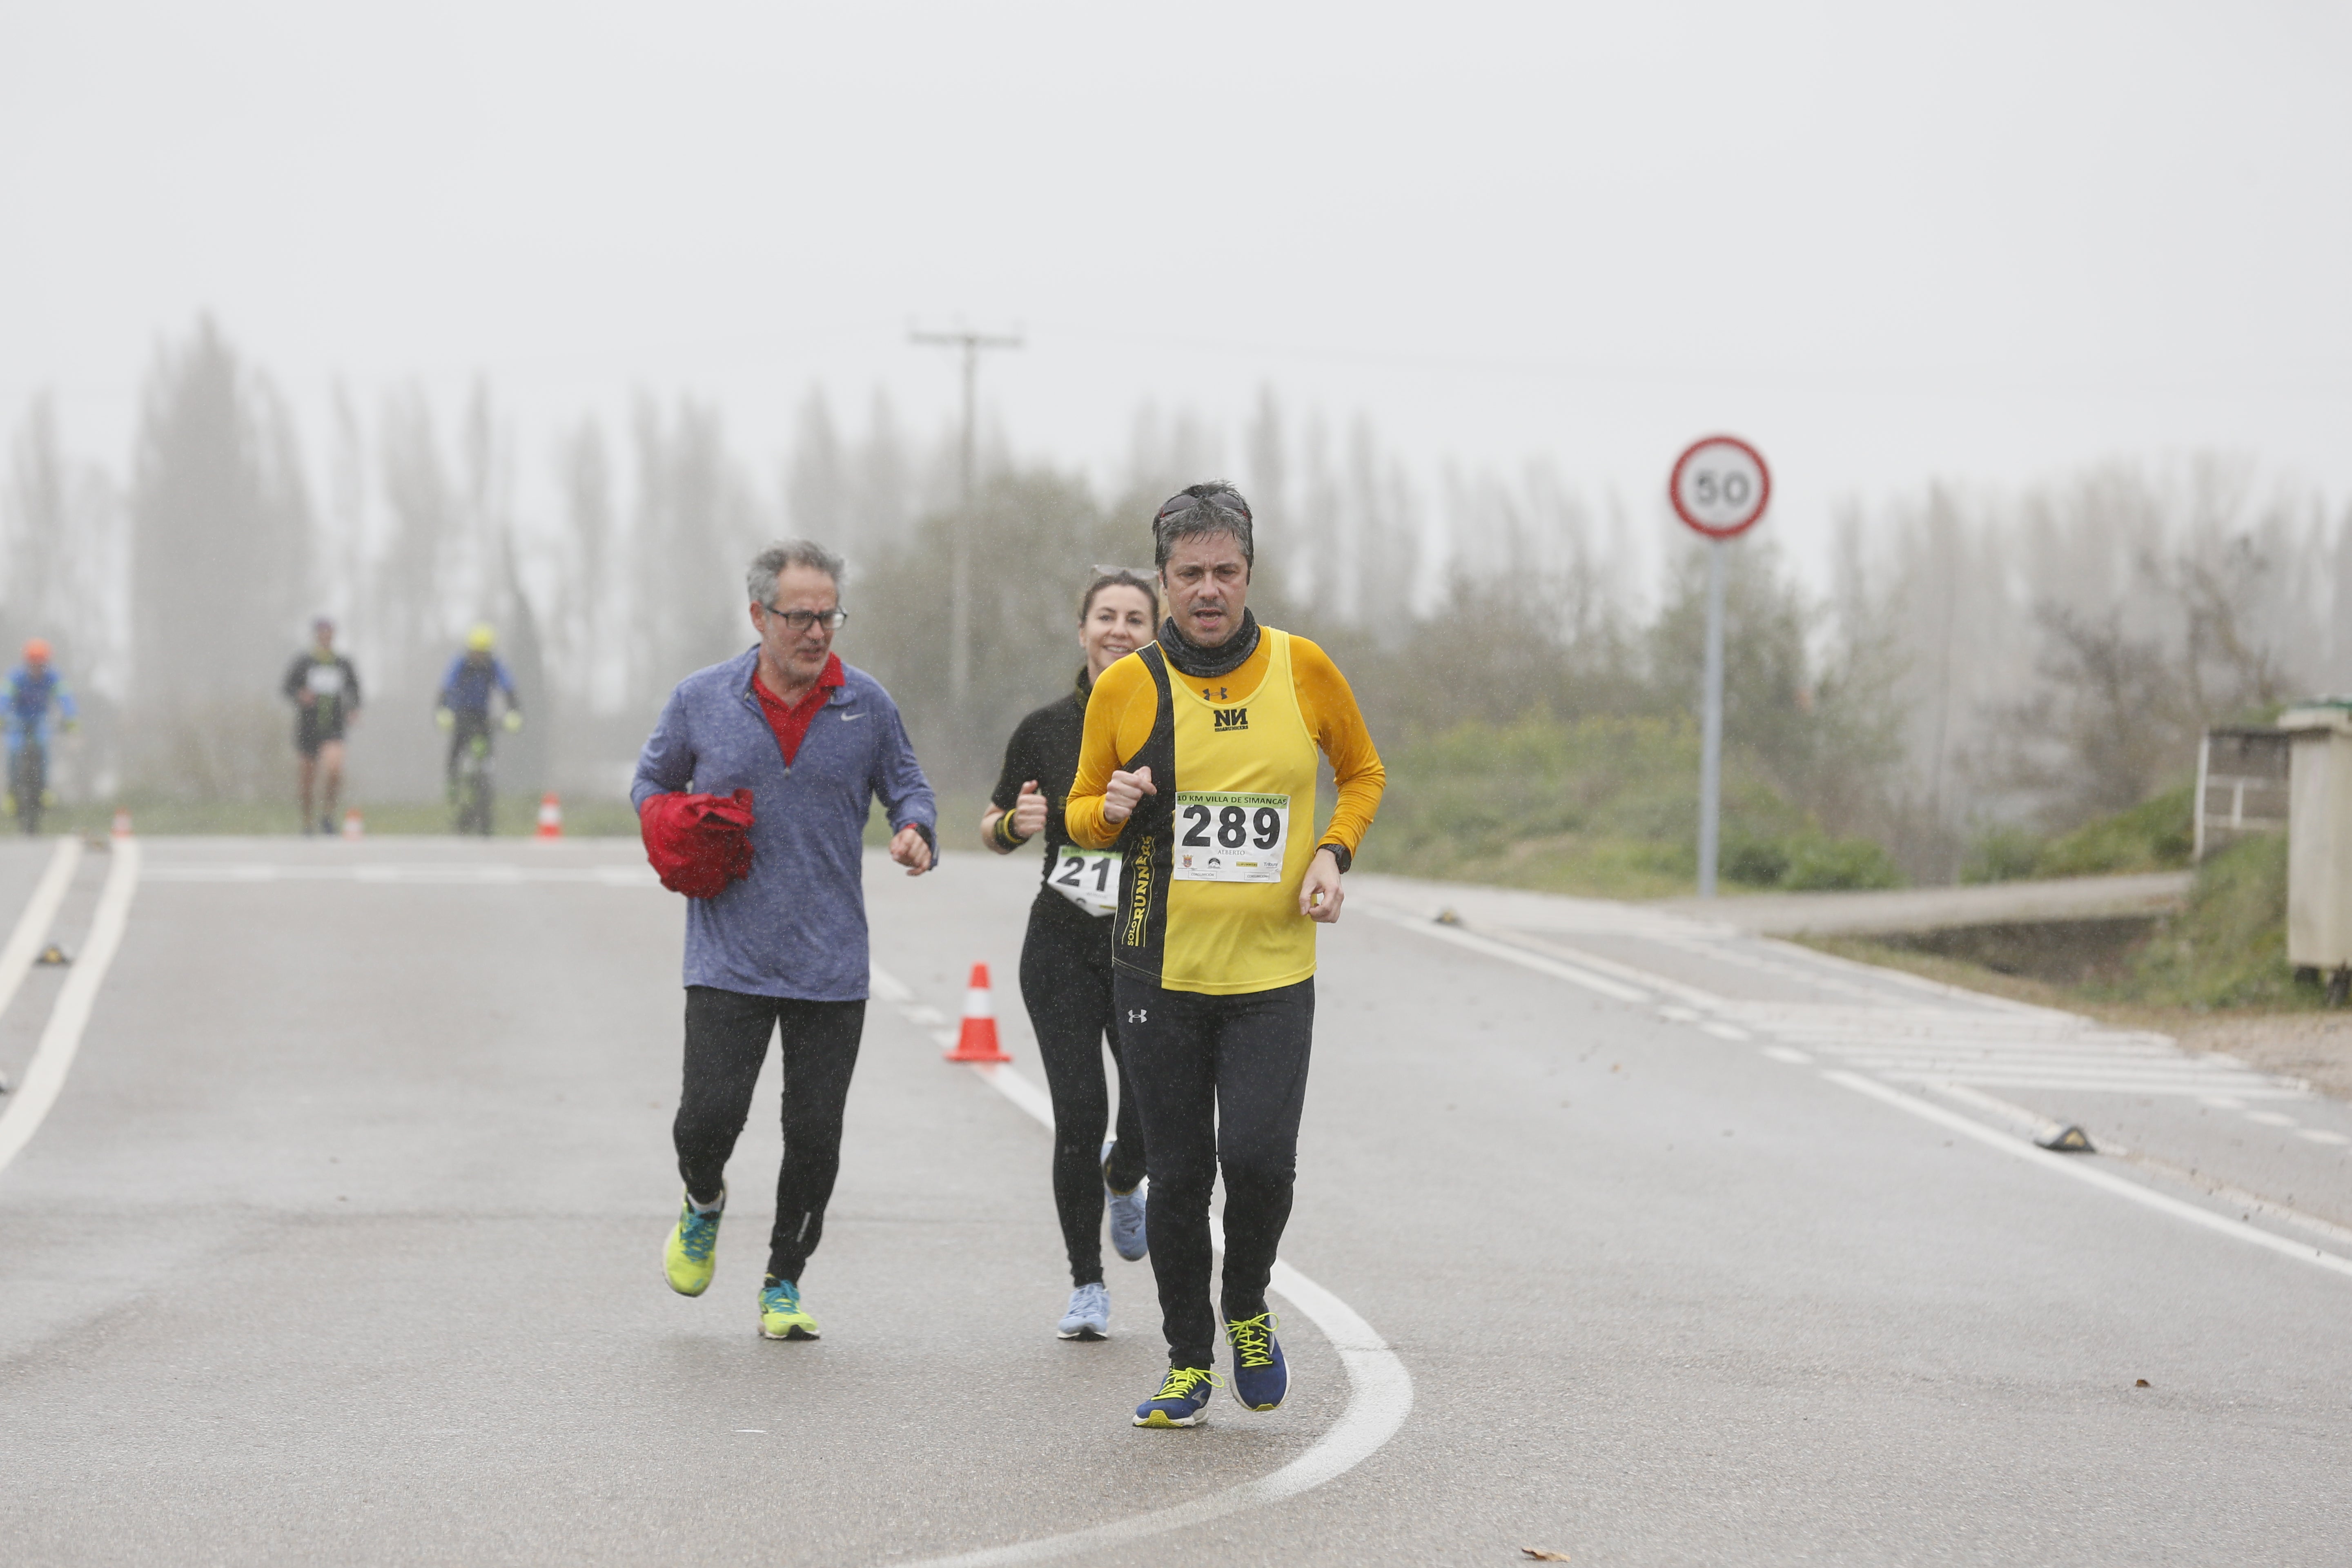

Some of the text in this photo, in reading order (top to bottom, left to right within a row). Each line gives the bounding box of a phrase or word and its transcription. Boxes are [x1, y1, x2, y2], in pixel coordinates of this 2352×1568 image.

[1697, 470, 1749, 506] 50
[1182, 804, 1280, 849] 289
[1056, 856, 1111, 892] 21
[1127, 836, 1152, 946] SOLO RUNNERS
